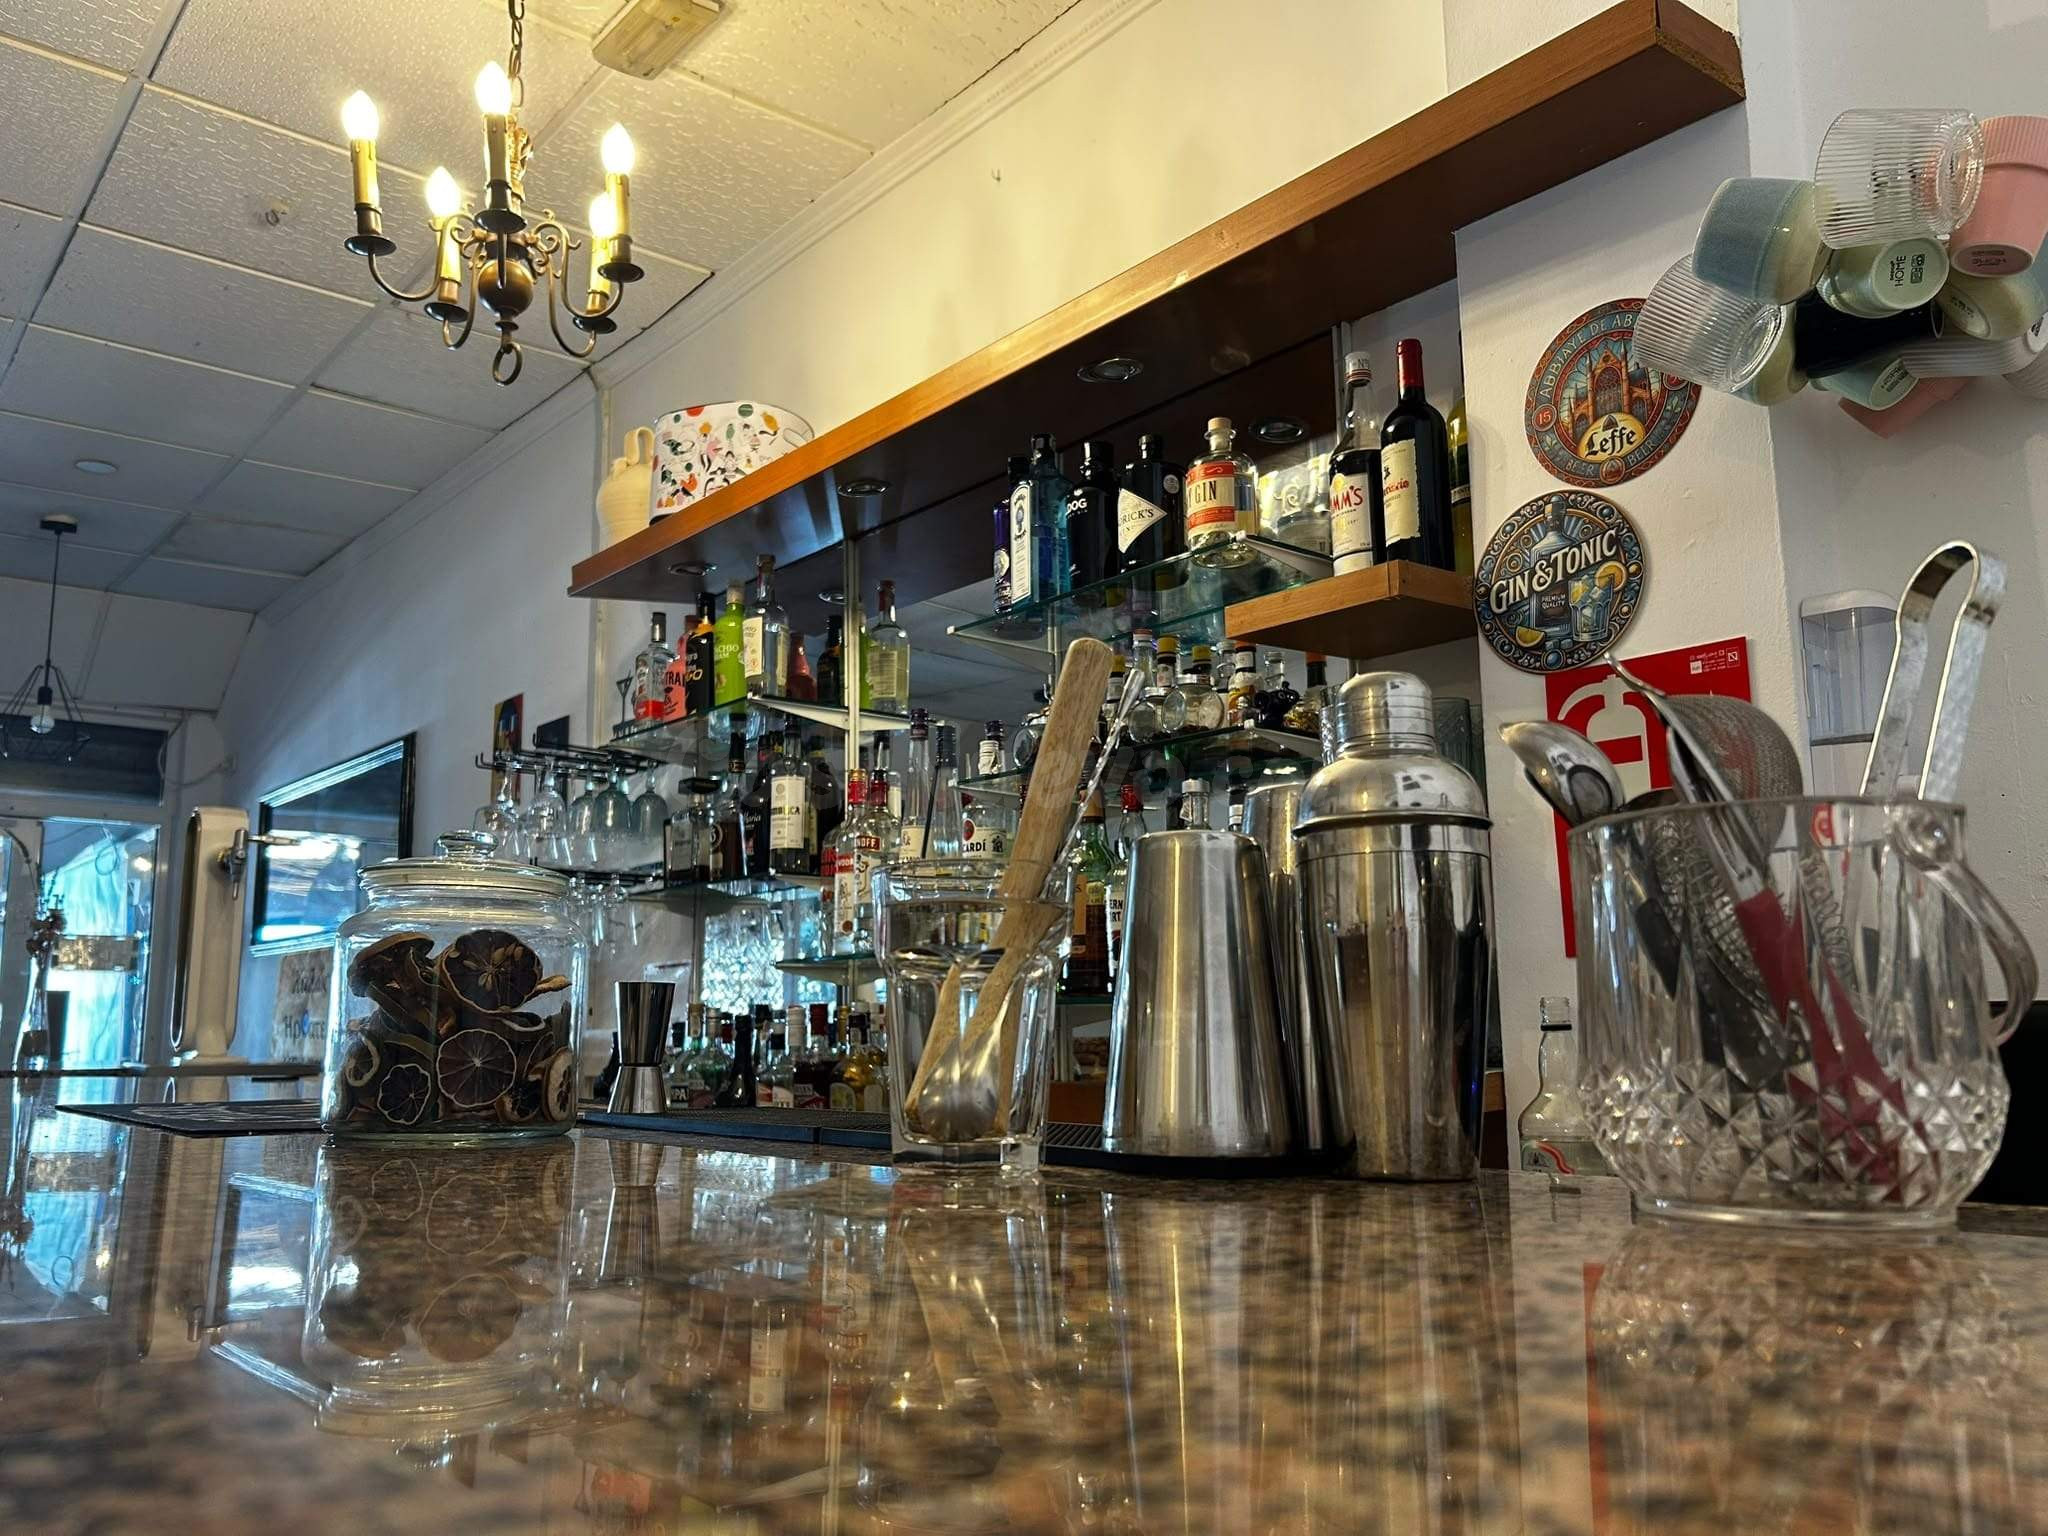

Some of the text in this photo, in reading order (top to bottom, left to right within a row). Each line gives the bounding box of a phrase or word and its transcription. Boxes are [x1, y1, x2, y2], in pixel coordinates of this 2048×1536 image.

[1895, 255, 1907, 287] HOME
[1585, 426, 1637, 458] Leffe
[1195, 480, 1217, 504] GIN
[1120, 508, 1155, 525] RICK'S
[1490, 569, 1531, 615] GIN
[1551, 529, 1618, 582] TONIC
[963, 838, 986, 853] ARDÍ
